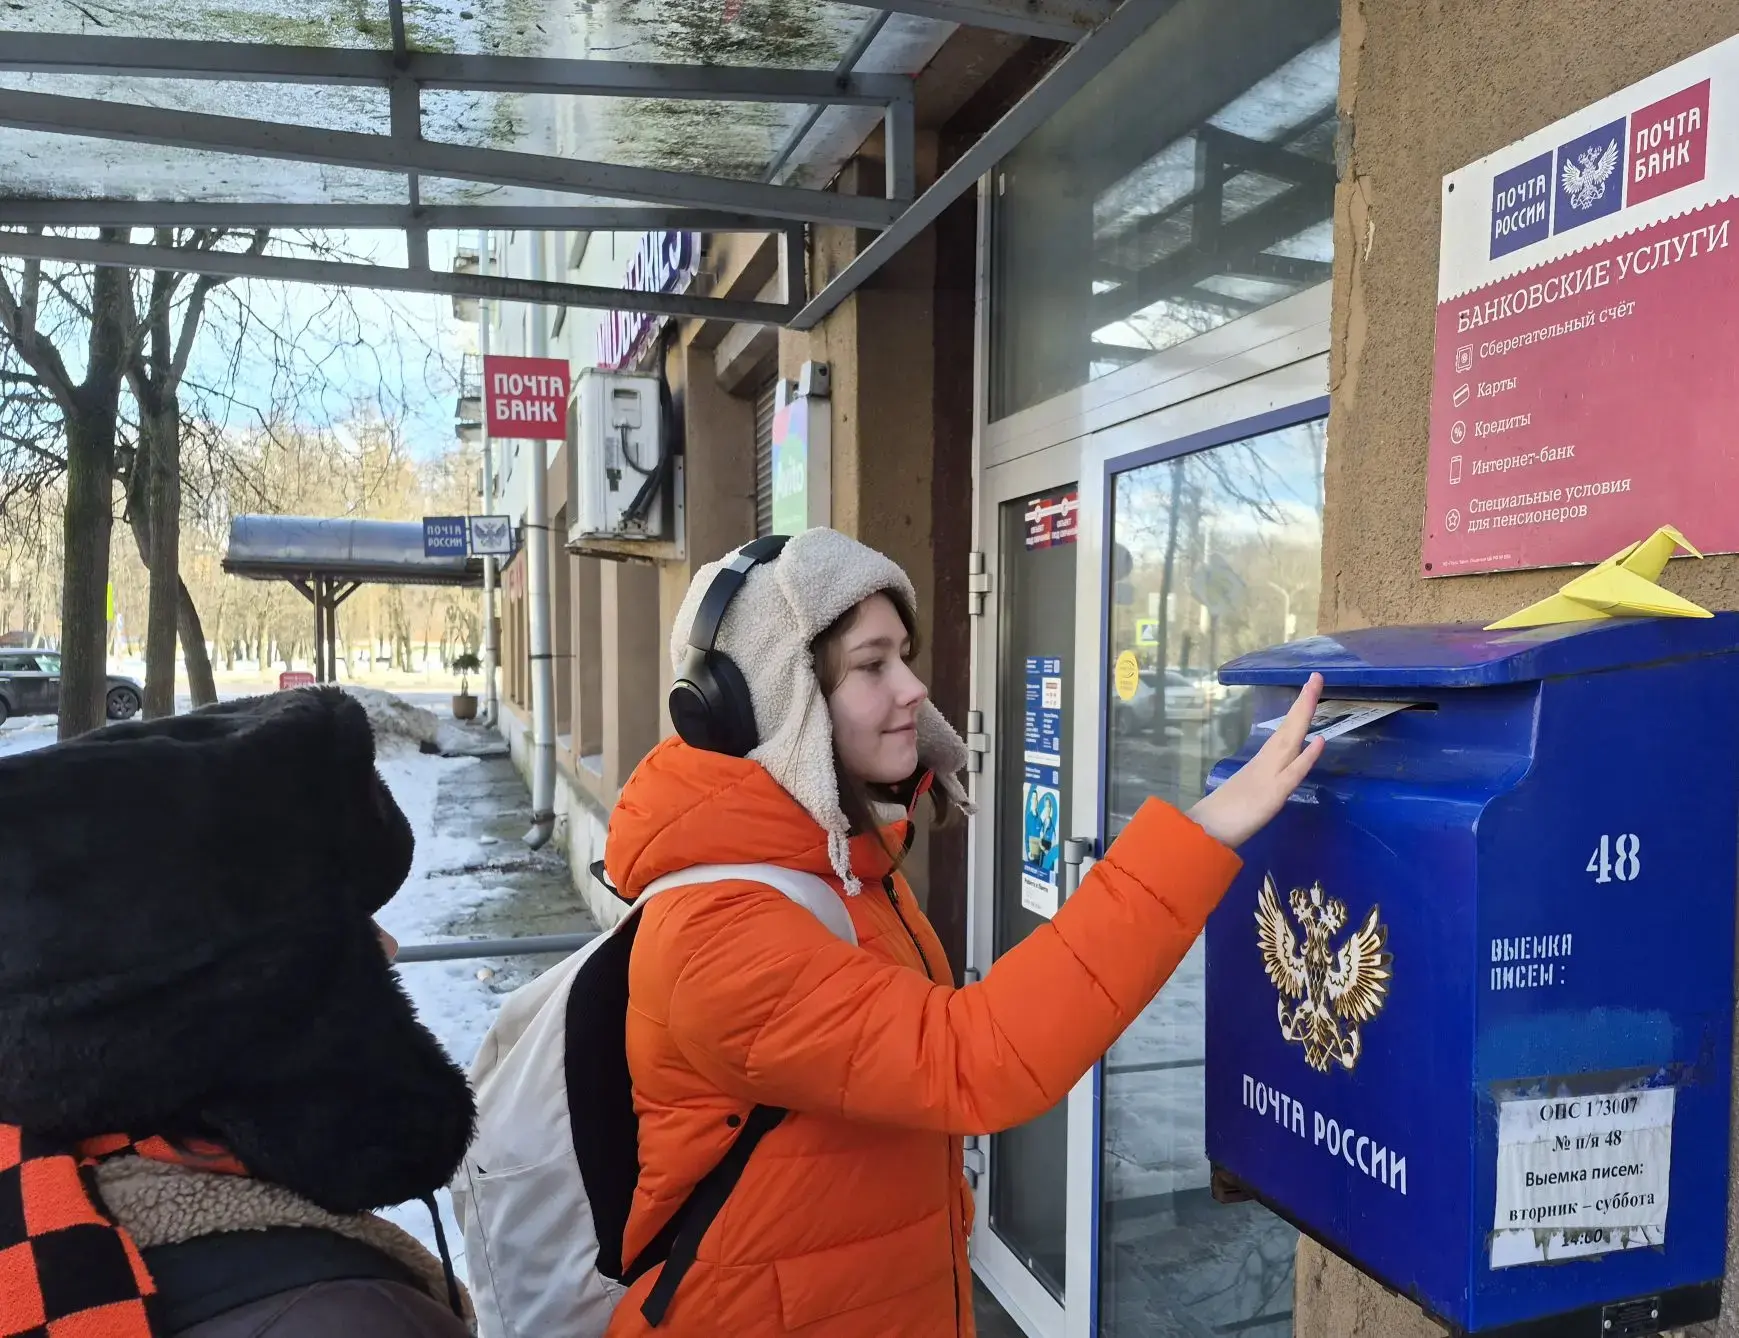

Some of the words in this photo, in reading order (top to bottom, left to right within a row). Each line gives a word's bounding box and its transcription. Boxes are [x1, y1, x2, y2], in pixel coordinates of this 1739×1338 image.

[1636, 107, 1701, 153] ПОЧТА
[1635, 140, 1692, 182] БАНК
[1496, 174, 1546, 213] ПОЧТА
[1495, 200, 1546, 239] РОССИИ
[1457, 259, 1610, 333] БАНКОВСКИЕ
[1616, 219, 1731, 281] УСЛУГИ
[1479, 310, 1596, 358] Сберегательный
[1599, 300, 1636, 324] счёт
[494, 373, 565, 398] ПОЧТА
[1476, 375, 1517, 398] Карты
[495, 398, 558, 422] БАНК
[1474, 413, 1532, 437] Кредиты
[1472, 444, 1576, 476] Интернет-банк
[1469, 486, 1562, 514] Специальные
[1565, 477, 1632, 503] условия
[427, 525, 462, 535] ПОЧТА
[1467, 514, 1491, 533] для
[1492, 504, 1588, 529] пенсионеров
[428, 537, 463, 547] РОССИИ
[1586, 833, 1641, 884] 48
[1491, 933, 1573, 962] ВЫЕМКА
[1540, 1102, 1581, 1122] ОПС
[1587, 1097, 1638, 1118] 173007
[1242, 1073, 1305, 1138] ПОЧТА
[1314, 1110, 1408, 1196] РОССИИ
[1552, 1135, 1571, 1152] №
[1576, 1132, 1600, 1151] п/я
[1604, 1129, 1622, 1147] 48
[1525, 1168, 1587, 1187] Выемка
[1592, 1162, 1644, 1180] писем:
[1509, 1201, 1578, 1223] вторник
[1595, 1191, 1655, 1215] суббота
